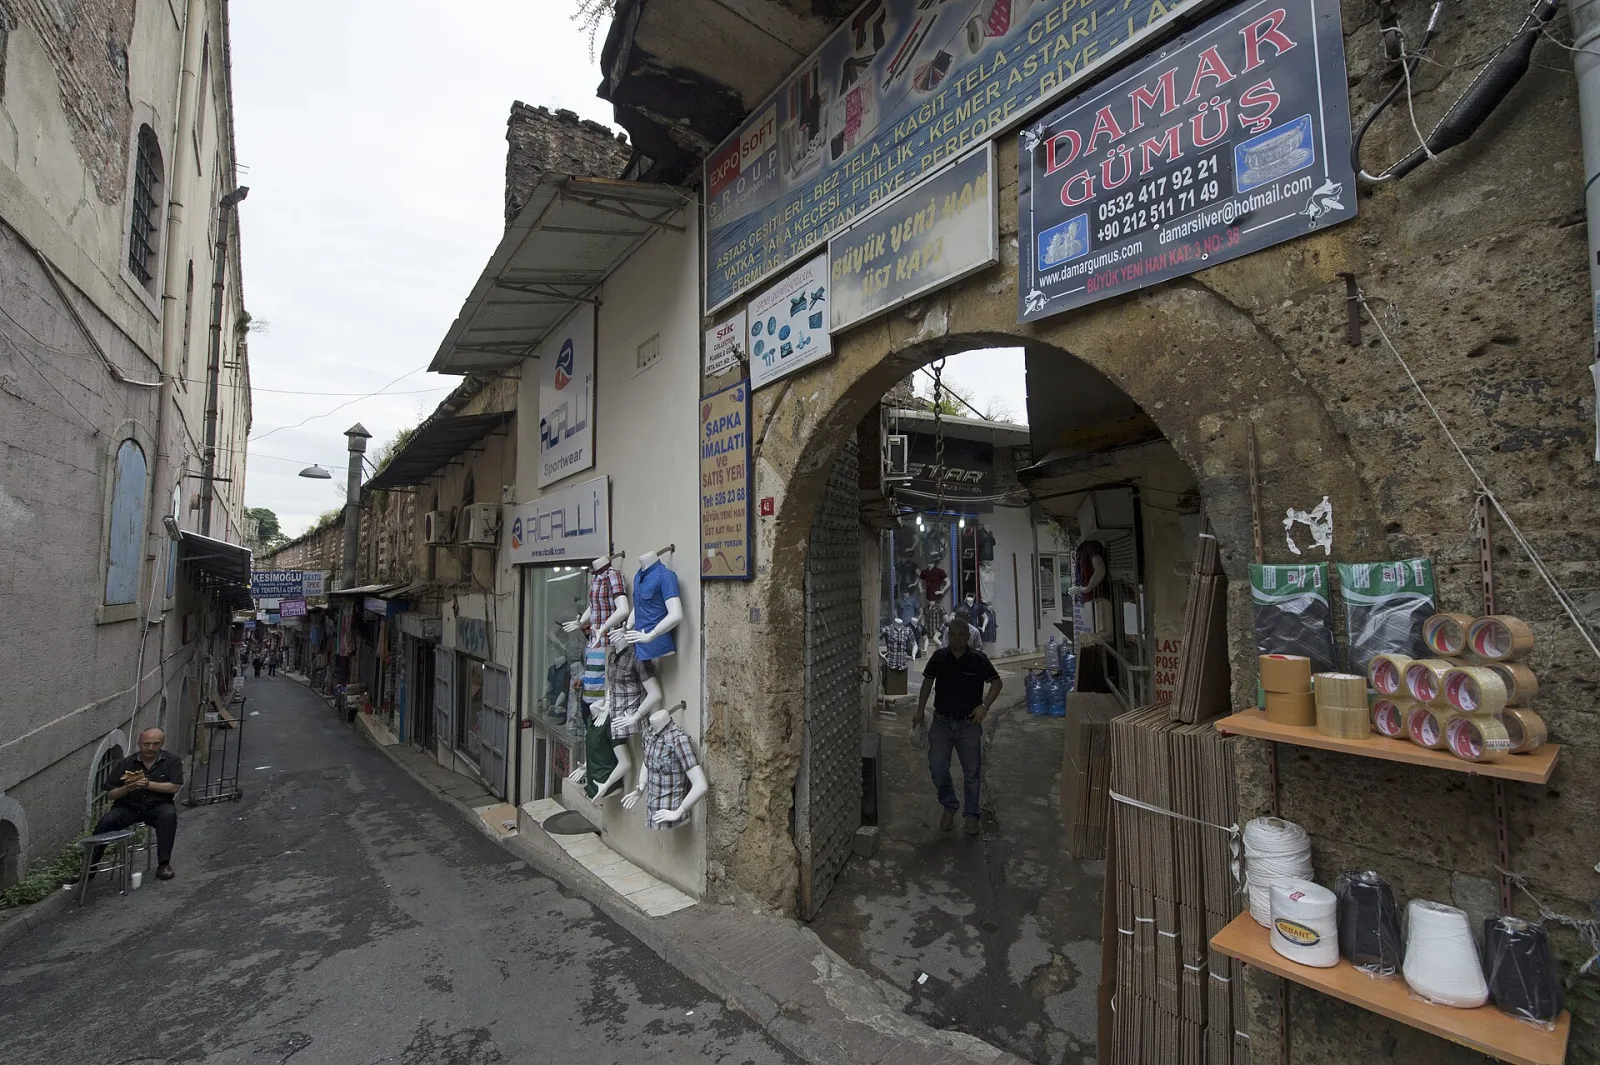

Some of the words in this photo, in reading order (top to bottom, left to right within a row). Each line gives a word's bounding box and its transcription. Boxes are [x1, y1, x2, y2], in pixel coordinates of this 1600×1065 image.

[1040, 40, 1099, 96] BİYE
[1127, 0, 1178, 38] LA
[1043, 8, 1297, 177] DAMAR
[710, 152, 739, 189] EXPO
[742, 118, 774, 158] SOFT
[716, 240, 747, 271] ASTAR
[814, 171, 840, 201] BEZ
[843, 143, 881, 181] TELA
[894, 90, 948, 144] KAĞIT
[954, 50, 1008, 98] TELA
[724, 255, 755, 281] VATKA
[763, 230, 792, 254] YAKA
[794, 189, 840, 234] KEÇESİ
[852, 142, 915, 196] FİTİLLİK
[930, 80, 1001, 144] KEMER
[1006, 10, 1098, 91] ASTARI
[1060, 78, 1281, 207] GÜMÜŞ
[1098, 190, 1134, 221] 0532
[1138, 181, 1166, 210] 417
[1172, 169, 1194, 192] 92
[1198, 156, 1218, 184] 21
[1098, 222, 1120, 243] +90
[1123, 212, 1147, 235] 212
[1150, 202, 1175, 226] 511
[1179, 193, 1195, 213] 71
[1200, 182, 1219, 208] 49
[1159, 174, 1313, 246] damarsilver@hotmail.com
[832, 232, 886, 282] BÜYÜK
[862, 263, 892, 297] ÜST
[1039, 240, 1143, 288] www.damargumus.com
[1087, 264, 1120, 293] BÜYÜK
[1121, 256, 1144, 285] YENİ
[1145, 254, 1167, 278] HAN
[1226, 227, 1240, 247] 36
[702, 432, 745, 460] İMALATI
[705, 411, 742, 442] ŞAPKA
[544, 447, 583, 478] Sportwear
[702, 468, 724, 489] SATIŞ
[725, 460, 745, 483] YERİ
[716, 454, 728, 468] ve
[715, 491, 726, 506] 526
[727, 489, 736, 504] 23
[737, 487, 745, 501] 68
[734, 508, 745, 519] HAN
[704, 525, 715, 537] ÜST
[1279, 923, 1311, 939] SEBANT
